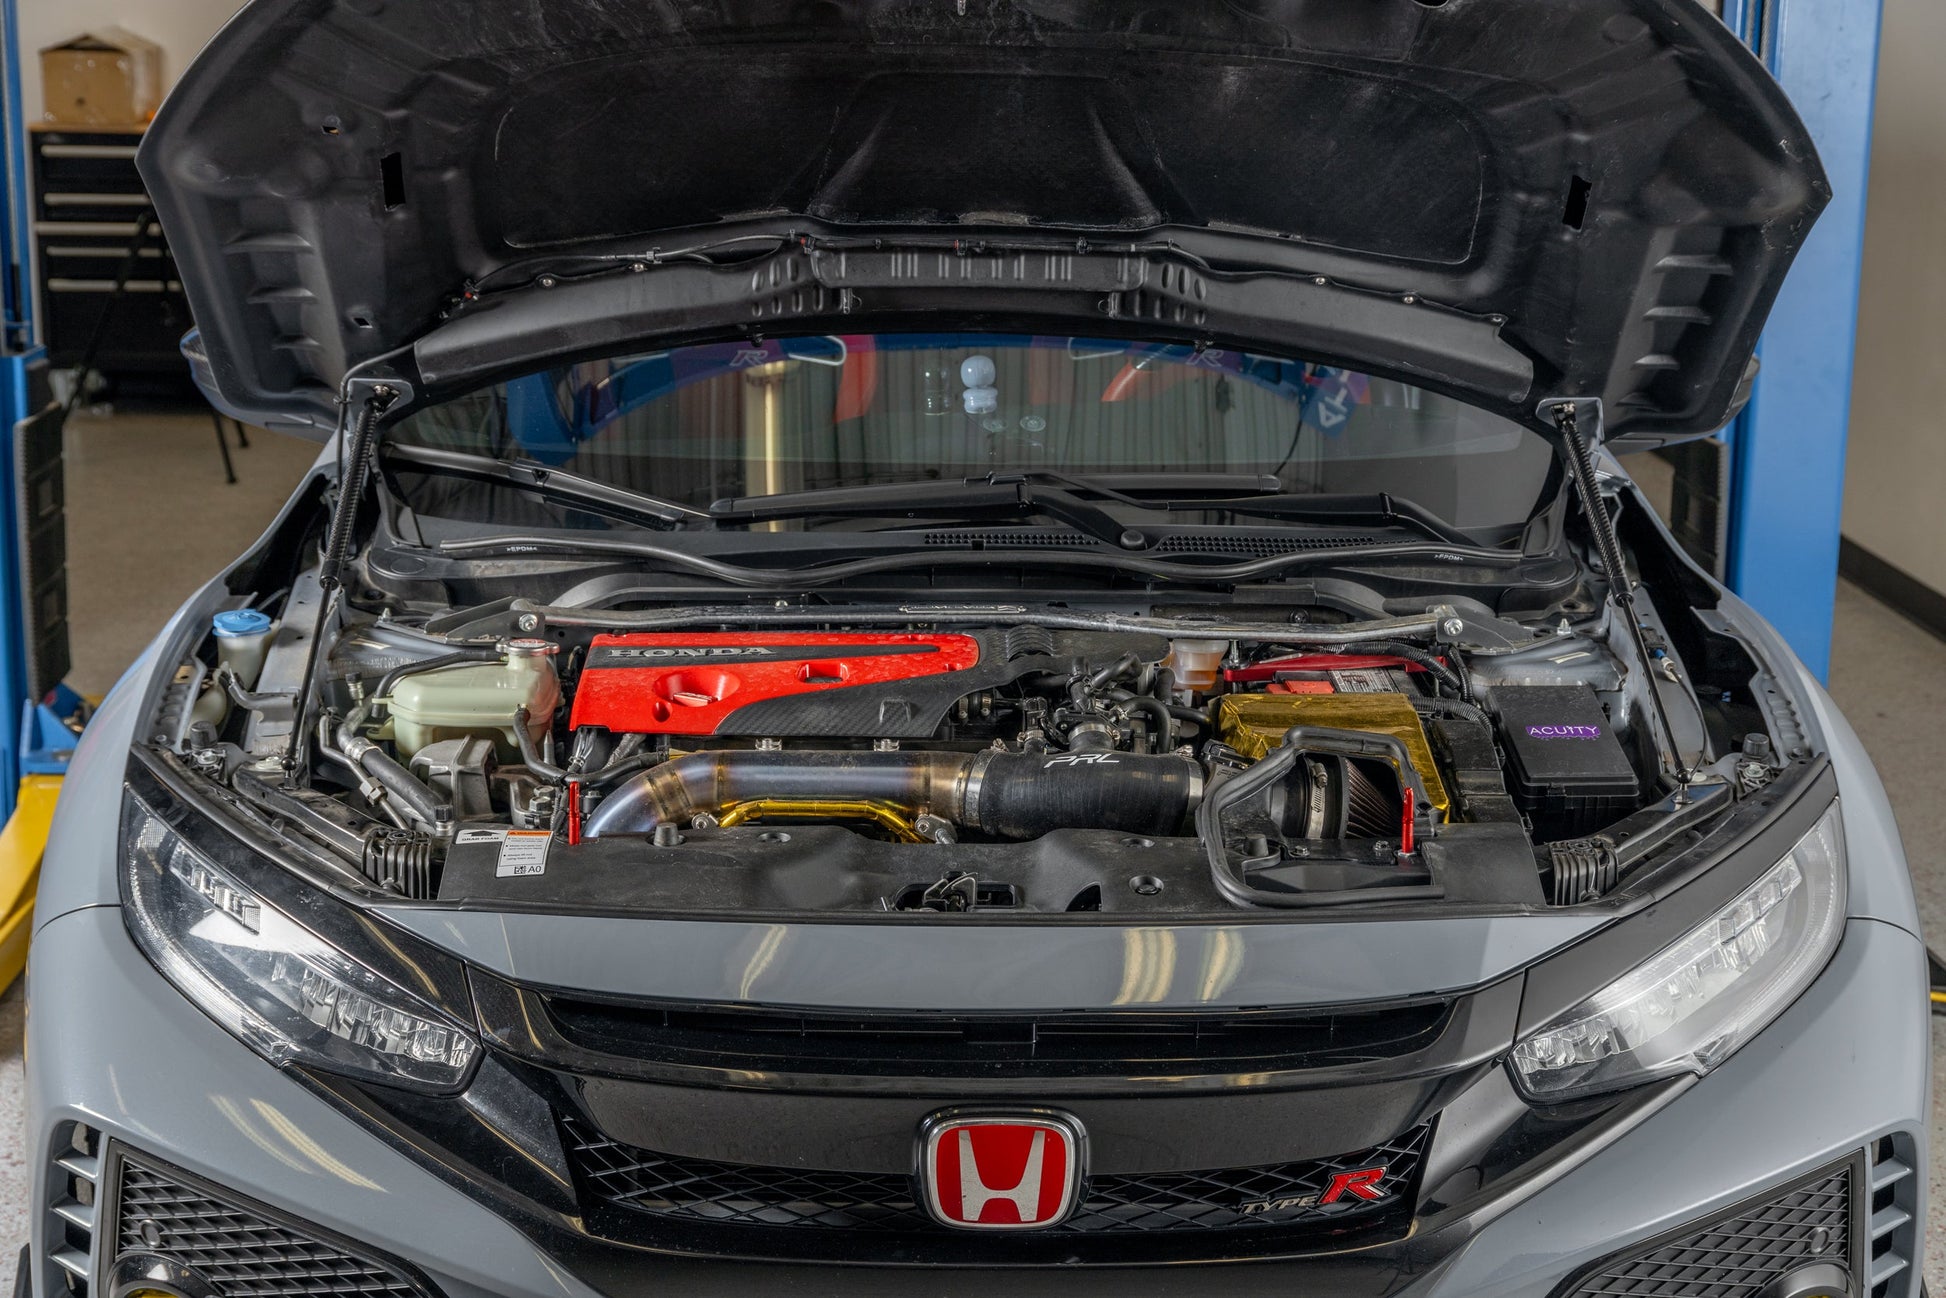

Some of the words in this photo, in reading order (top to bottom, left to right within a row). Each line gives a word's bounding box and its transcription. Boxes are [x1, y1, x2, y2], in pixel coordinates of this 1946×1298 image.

[607, 647, 777, 658] HONDA
[1530, 726, 1598, 735] ACUITY
[1043, 753, 1120, 768] PRL
[1242, 1196, 1318, 1214] TYPE
[1316, 1164, 1389, 1206] R
